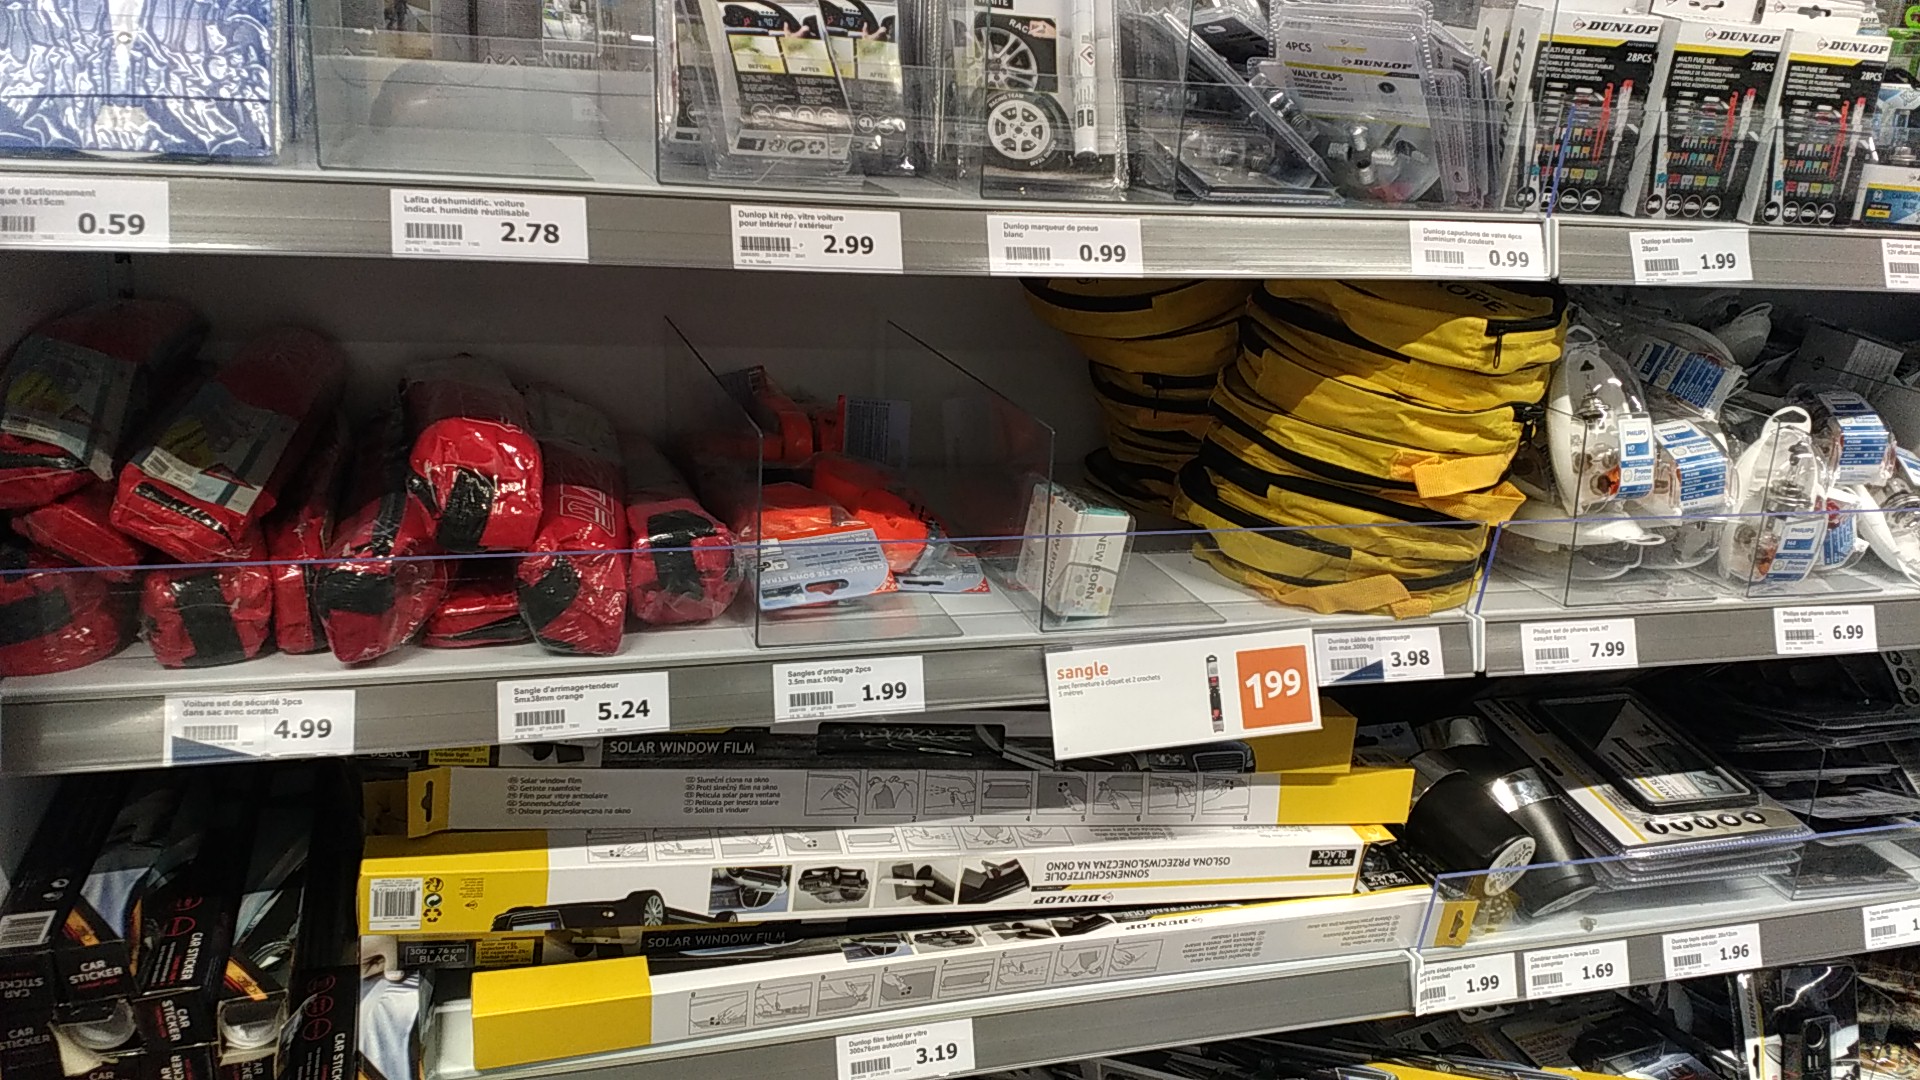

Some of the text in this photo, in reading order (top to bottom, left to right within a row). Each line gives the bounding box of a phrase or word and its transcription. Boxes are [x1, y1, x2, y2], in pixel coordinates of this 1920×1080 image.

[1587, 21, 1658, 35] DUNLOP
[1718, 31, 1781, 44] DUNLOP
[1286, 42, 1312, 52] 4PCS
[1829, 41, 1888, 54] DUNLOP
[1626, 52, 1652, 63] 28PCS
[1354, 59, 1412, 69] DUNLOP
[1751, 62, 1774, 72] 28PCS
[1292, 69, 1343, 81] VALVE CAPS
[1861, 72, 1882, 81] 28PCS
[8, 187, 96, 197] de stationnement
[20, 198, 64, 206] 15x15cm
[404, 196, 429, 204] Lafita
[494, 200, 525, 208] voiture
[440, 207, 530, 217] humidité réutilisable
[738, 210, 767, 219] Dunlop
[780, 212, 796, 220] rép.
[817, 214, 844, 222] voiture
[78, 212, 145, 235] 0.59
[739, 220, 833, 230] pour intérieur extérieur
[1003, 222, 1029, 230] Dunlop
[1031, 224, 1065, 232] marqueur
[501, 222, 560, 244] 2.78
[1423, 228, 1446, 236] Dunlop
[824, 235, 874, 254] 2.99
[1080, 244, 1126, 262] 0.99
[1489, 250, 1529, 267] 0.99
[1701, 253, 1736, 269] 1.99
[1085, 536, 1107, 600] NEW BORN
[790, 571, 815, 580] DOWN
[1833, 625, 1863, 639] 6.99
[1590, 641, 1624, 657] 7.99
[1391, 650, 1430, 667] 3.98
[788, 666, 871, 678] Sangles d'arrimage 2pcs
[1057, 661, 1109, 681] sangle
[806, 676, 843, 684] max.100kg
[1071, 680, 1099, 689] fermeture
[1106, 678, 1123, 687] cliquet
[514, 682, 619, 696] Sangle d'arrimage+tendeur
[862, 682, 907, 701] 1.99
[1246, 668, 1301, 709] 199
[245, 698, 280, 706] sécurité
[282, 698, 302, 707] 3pcs
[514, 693, 584, 704] 5mx38mm orange
[598, 700, 650, 721] 5.24
[274, 718, 332, 739] 4.99
[609, 741, 754, 755] SOLAR WINDOW FILM
[1318, 850, 1347, 858] BLACK
[1046, 861, 1092, 871] NA OKNO
[1044, 869, 1149, 881] SONNENSCHUTZFOLIE
[1033, 894, 1100, 905] DUNLOP
[1125, 918, 1189, 930] DUNLOP
[647, 931, 786, 949] SOLAR WINDOW FILM
[1672, 937, 1688, 945] Dunlop
[180, 932, 204, 980] CAR STICKER
[1720, 944, 1749, 960] 1.96
[419, 954, 458, 963] BLACK
[80, 960, 106, 972] CAR
[1437, 966, 1462, 974] élastiques
[1582, 962, 1614, 980] 1.69
[68, 966, 123, 984] STICKER
[1466, 975, 1500, 993] 1.99
[4, 988, 31, 998] CAR
[162, 1000, 182, 1042] STICKER
[176, 1008, 191, 1029] CAR
[8, 1027, 34, 1039] CAR
[334, 1032, 345, 1054] CAR
[849, 1038, 872, 1047] Dunlop
[849, 1039, 917, 1055] 300x76cm autocollant
[916, 1043, 957, 1064] 3.19
